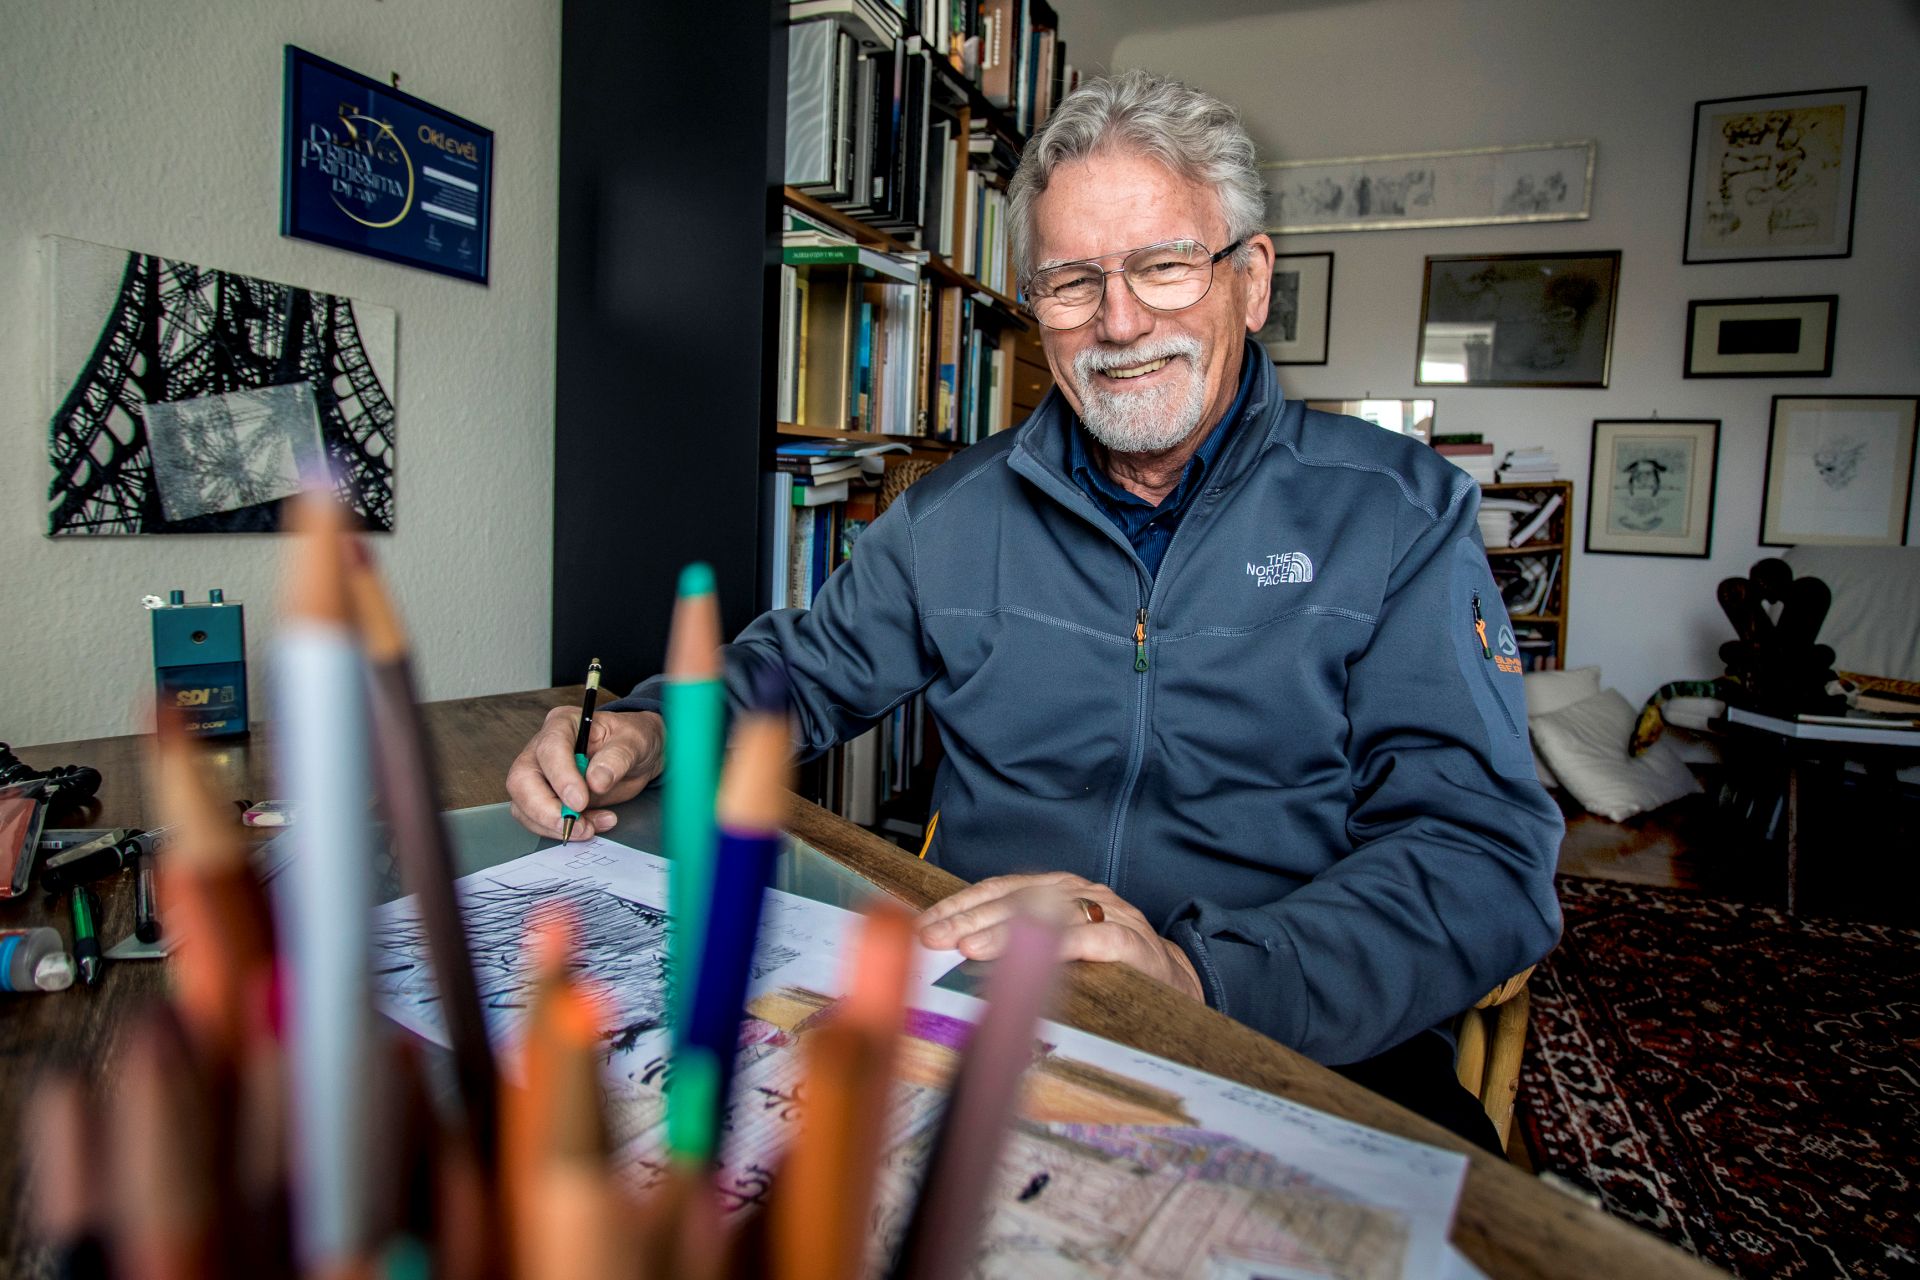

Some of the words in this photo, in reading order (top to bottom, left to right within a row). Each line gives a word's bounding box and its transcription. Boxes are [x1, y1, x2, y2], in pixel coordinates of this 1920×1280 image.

[1266, 552, 1292, 565] THE
[1246, 562, 1291, 576] NORTH
[1257, 573, 1288, 587] FACE
[176, 688, 209, 706] SDI
